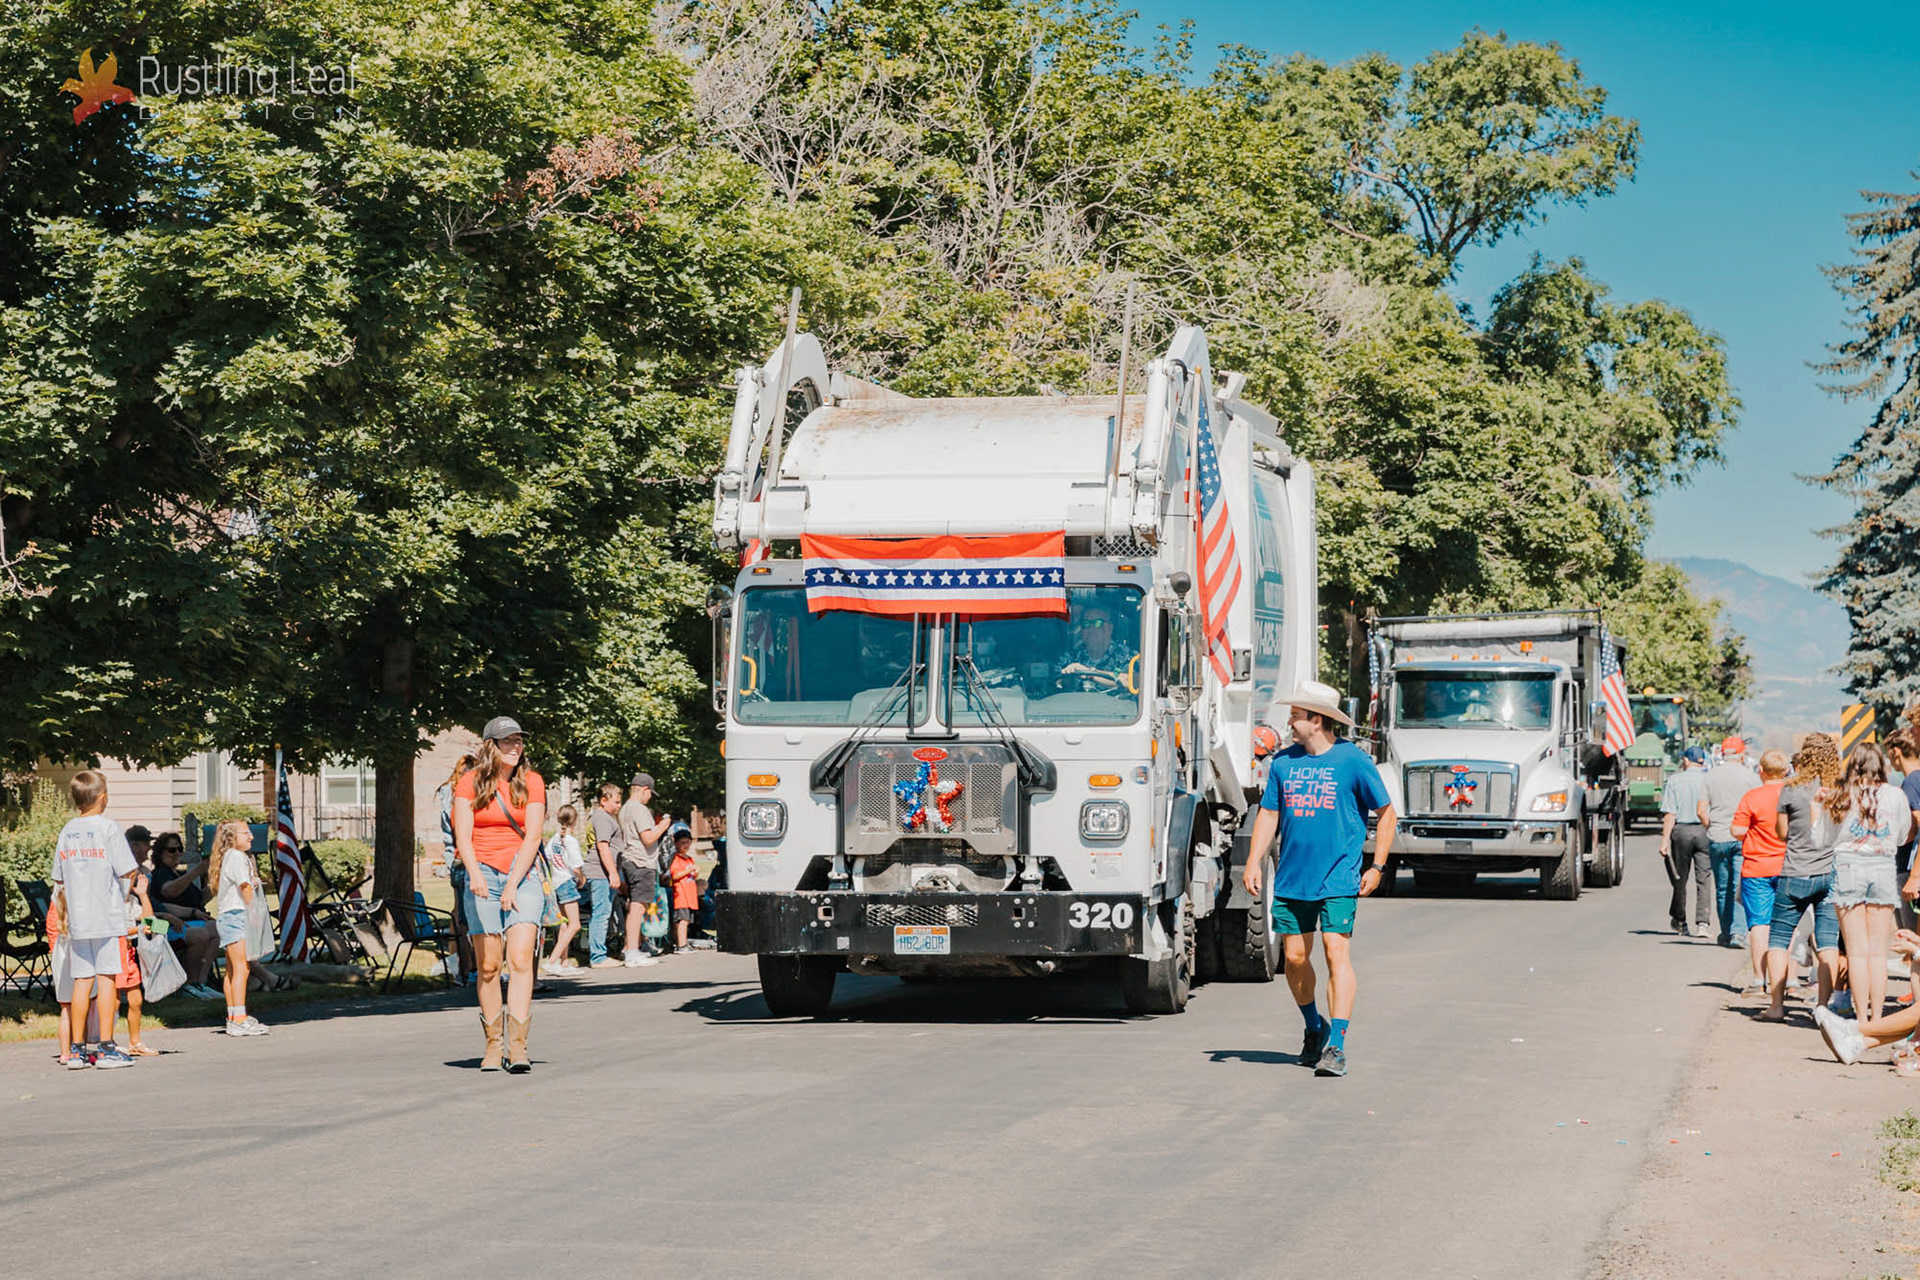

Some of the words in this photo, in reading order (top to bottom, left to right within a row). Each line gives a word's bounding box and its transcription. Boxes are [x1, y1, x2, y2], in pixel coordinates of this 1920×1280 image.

[1289, 766, 1335, 780] HOME
[1283, 780, 1304, 793] OF
[1306, 781, 1338, 795] THE
[59, 848, 78, 861] NW
[80, 848, 106, 860] YORK
[1068, 901, 1134, 929] 320
